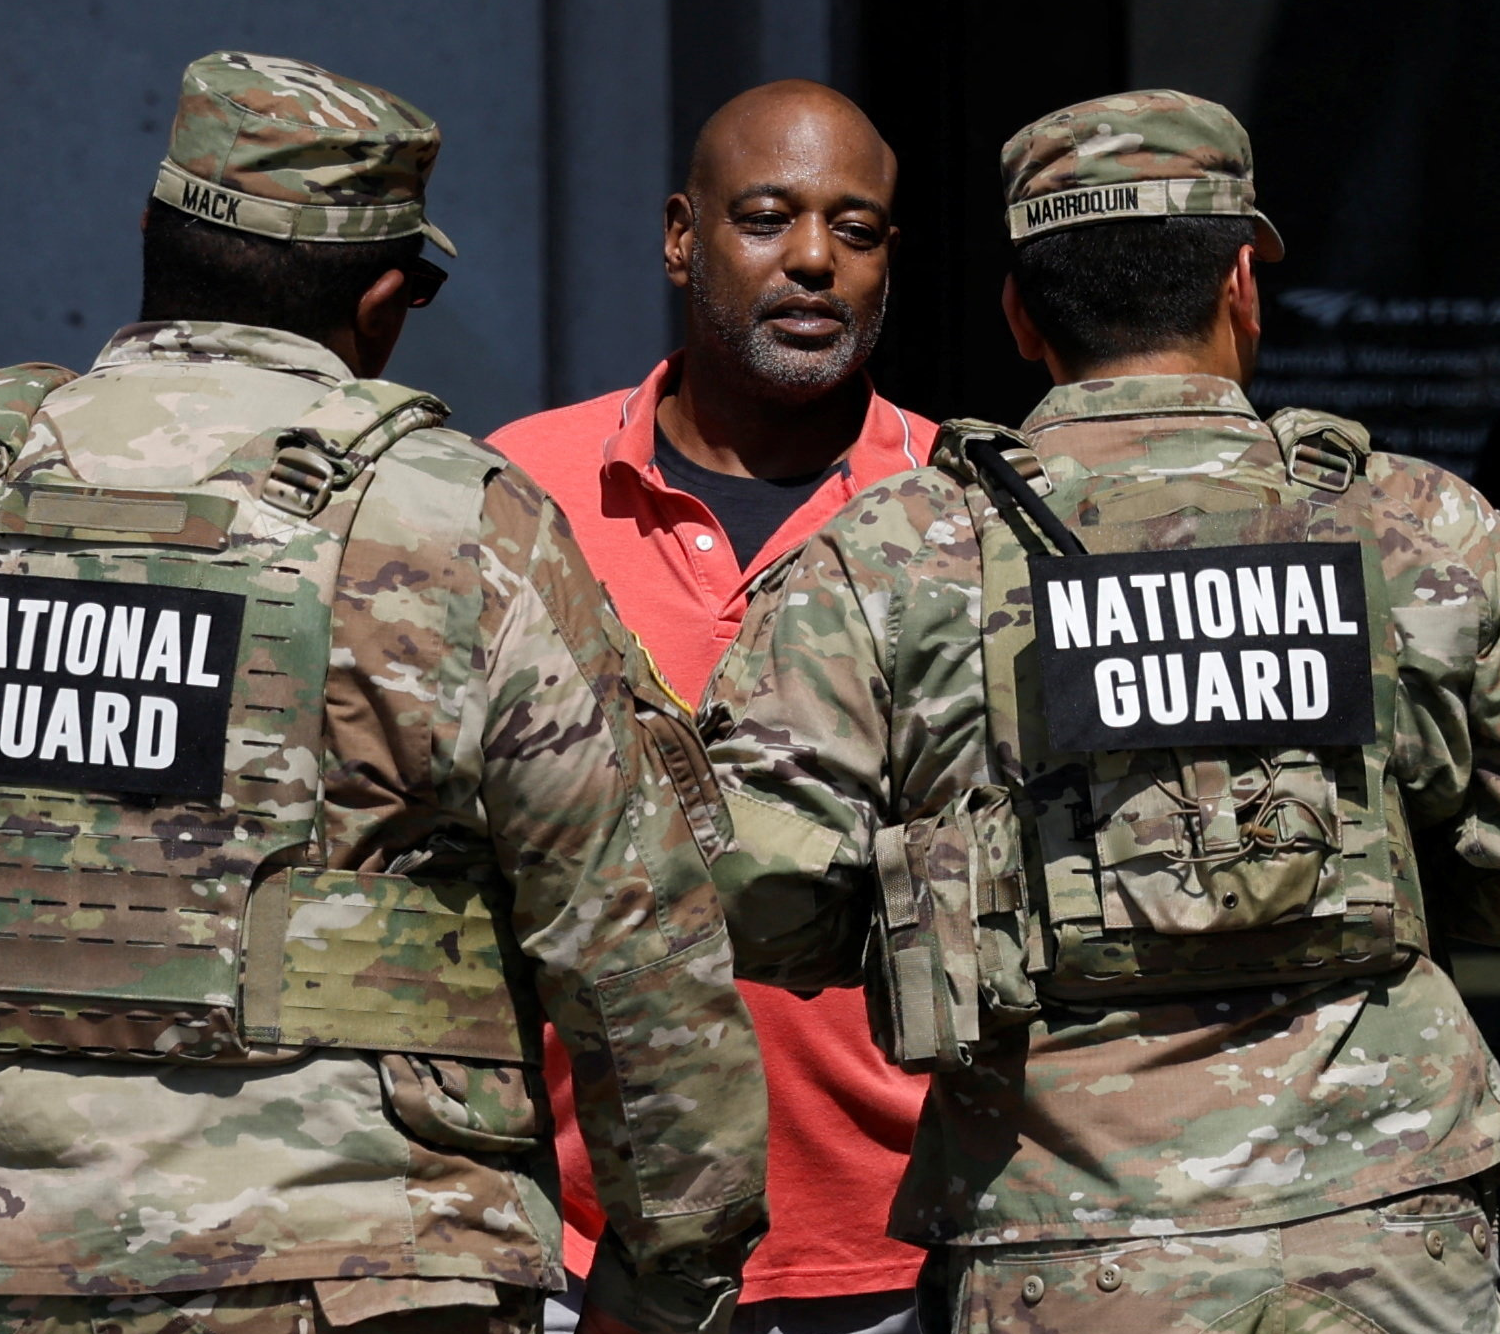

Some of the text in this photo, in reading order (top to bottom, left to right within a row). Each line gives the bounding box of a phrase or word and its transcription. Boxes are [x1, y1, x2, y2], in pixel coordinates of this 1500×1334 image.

[182, 181, 242, 225] MACK
[1026, 187, 1139, 228] MARROQUIN
[1047, 564, 1358, 650] NATIONAL
[1094, 648, 1331, 728] GUARD
